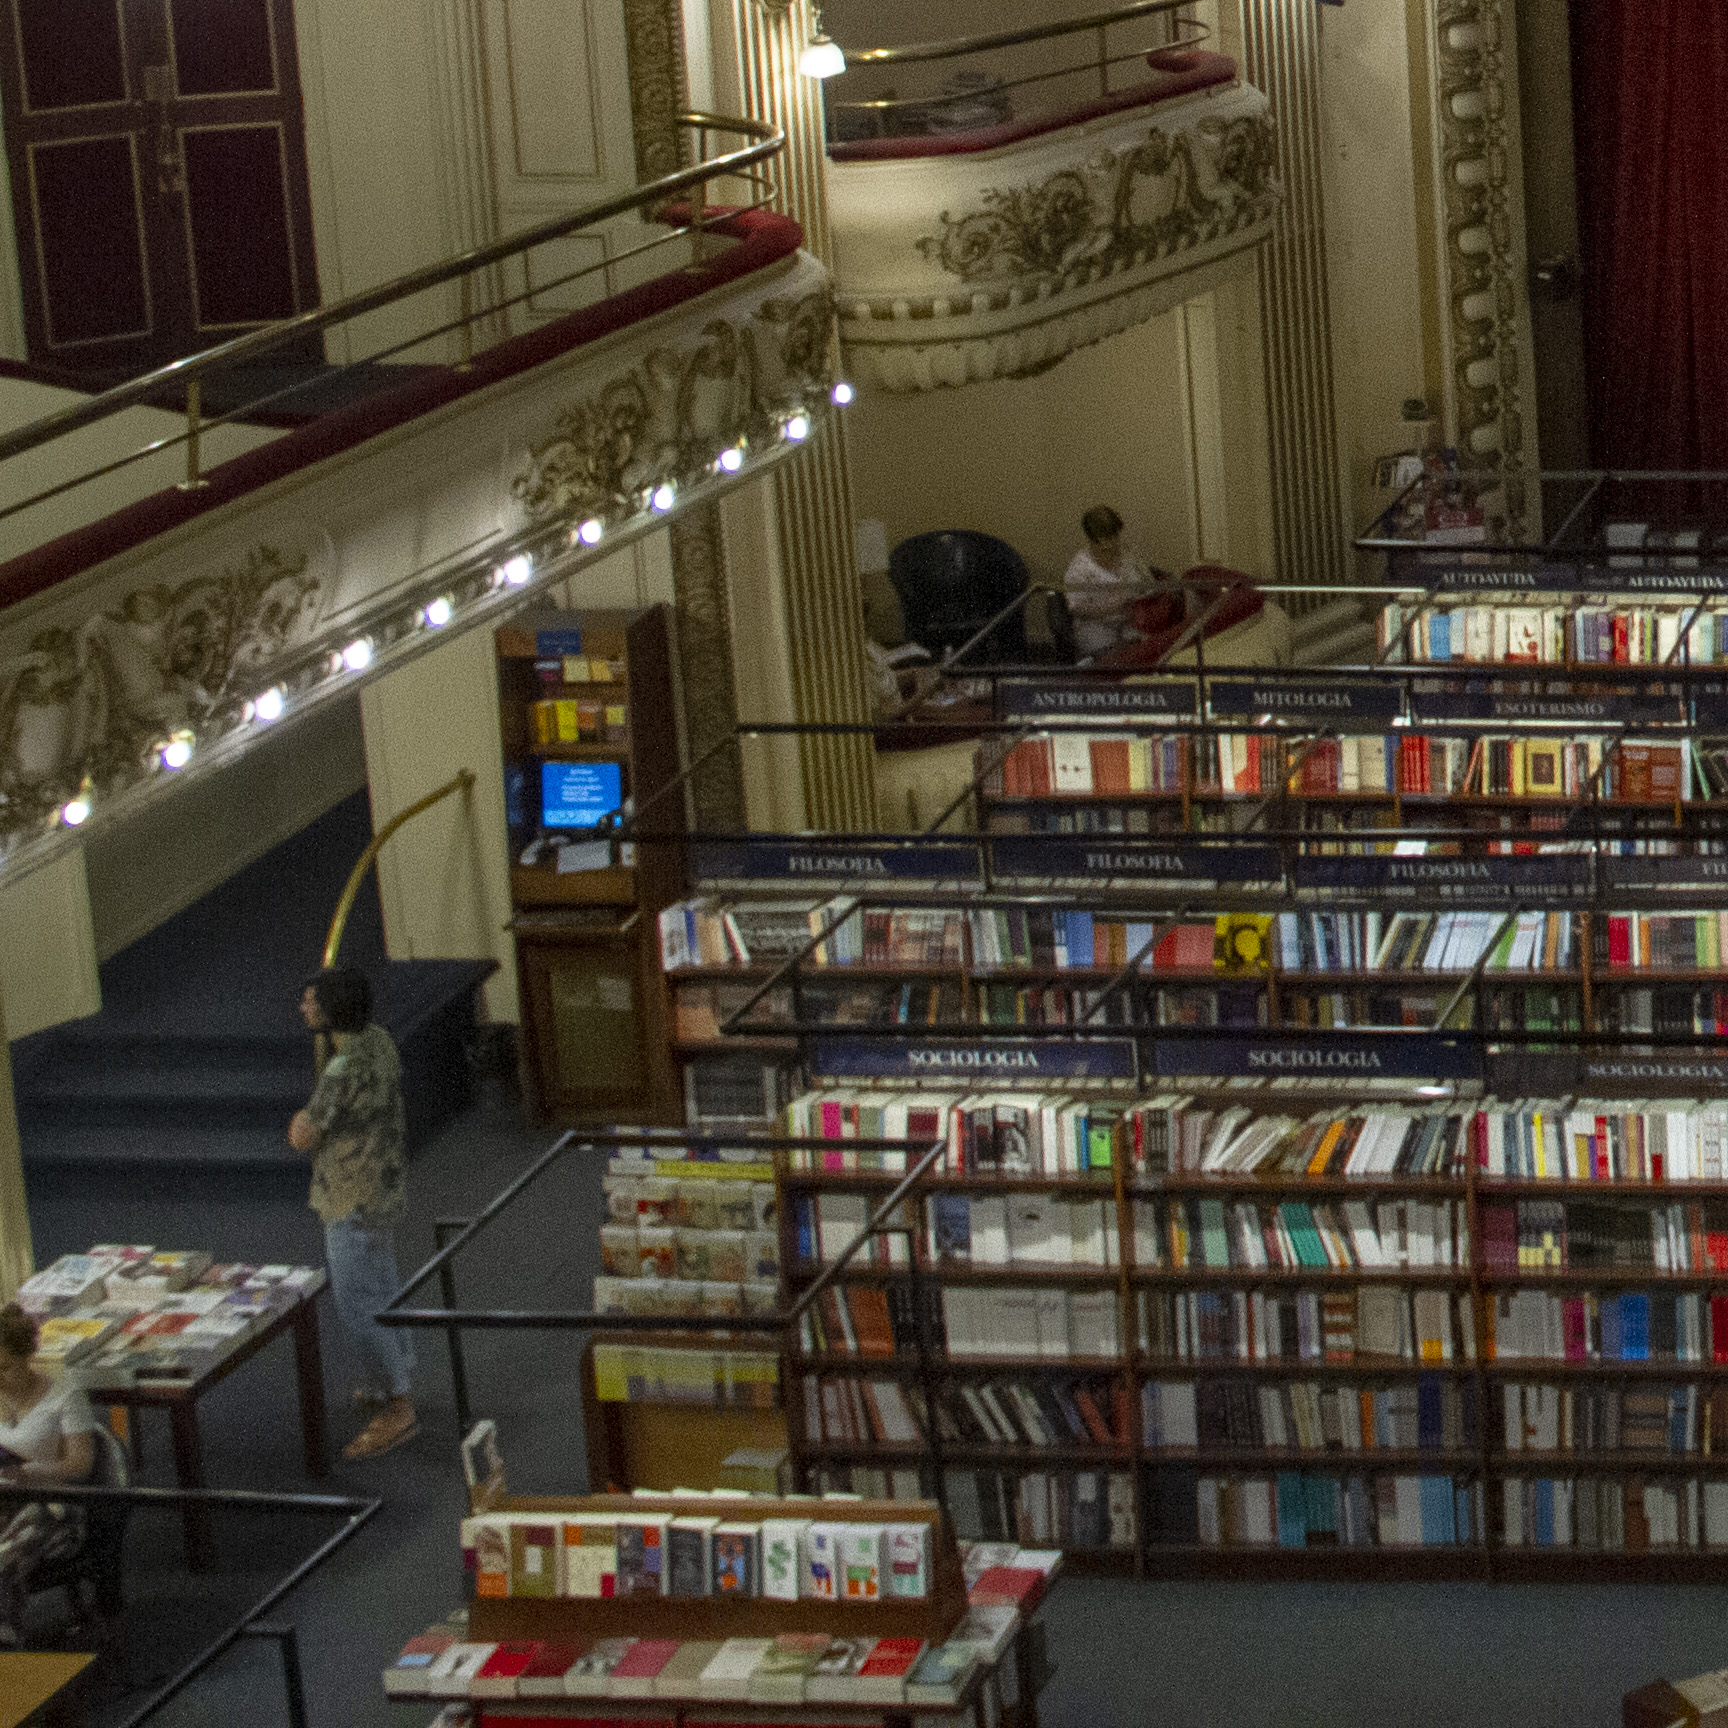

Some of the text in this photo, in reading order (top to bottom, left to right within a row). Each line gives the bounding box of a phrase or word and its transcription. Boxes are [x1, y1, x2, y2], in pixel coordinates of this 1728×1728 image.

[1441, 572, 1536, 588] AUTOAYUDA
[1628, 575, 1725, 590] AUTOAYUDA
[1033, 692, 1167, 708] ANTROPOLOGIA
[1253, 691, 1351, 707] MITOLOGIA
[1495, 702, 1605, 717] ESOTERISMO
[788, 856, 886, 872] FILOSOFIA
[1086, 854, 1184, 871] FILOSOFIA
[1390, 862, 1490, 878] FILOSOFIA
[908, 1050, 1039, 1067] SOCIOLOGIA
[1248, 1050, 1381, 1068] SOCIOLOGIA
[1588, 1064, 1724, 1079] SOCIOLOGIA
